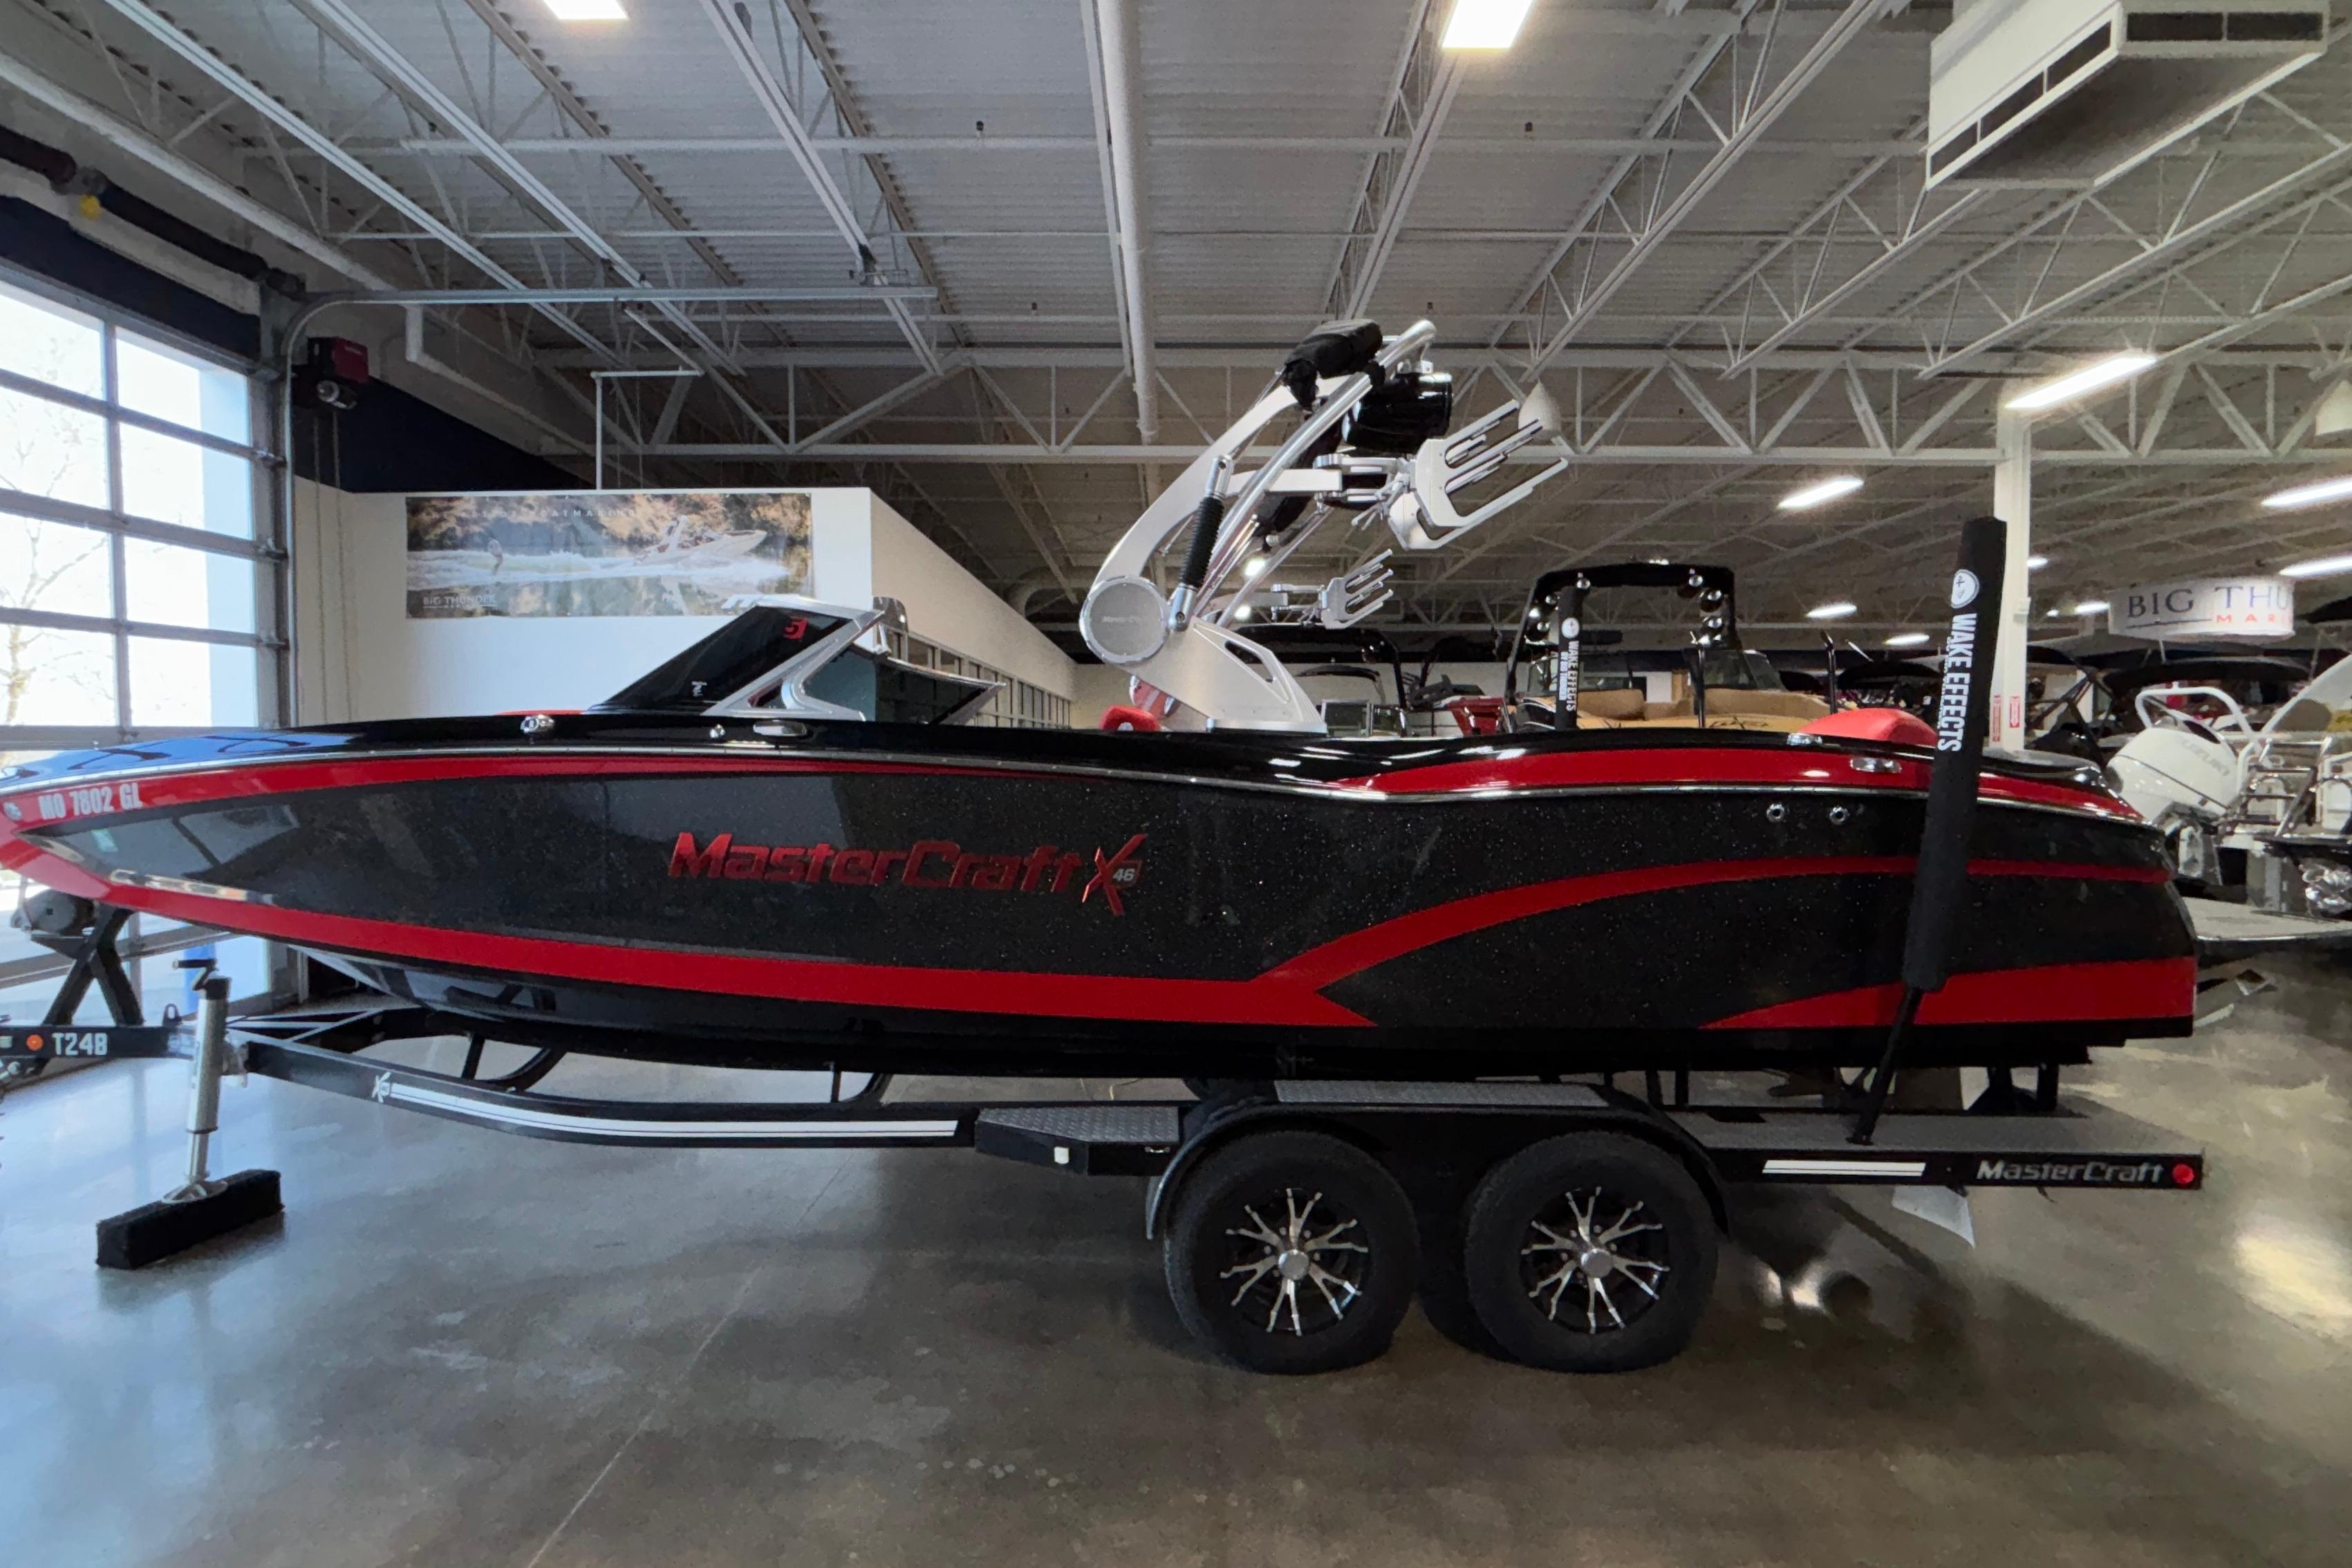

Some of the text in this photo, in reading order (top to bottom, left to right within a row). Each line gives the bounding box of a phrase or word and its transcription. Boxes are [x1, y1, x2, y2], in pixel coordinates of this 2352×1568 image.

[2127, 588, 2194, 617] BIG
[1948, 613, 1977, 671] WAKE
[1565, 640, 1580, 711] WAKE EFFECTS
[1937, 673, 1970, 752] EFFECTS
[37, 783, 143, 821] MO 7802 GL
[667, 832, 1082, 893] MasterCraft
[1112, 868, 1135, 881] 46
[1975, 1159, 2165, 1184] MasterCraft
